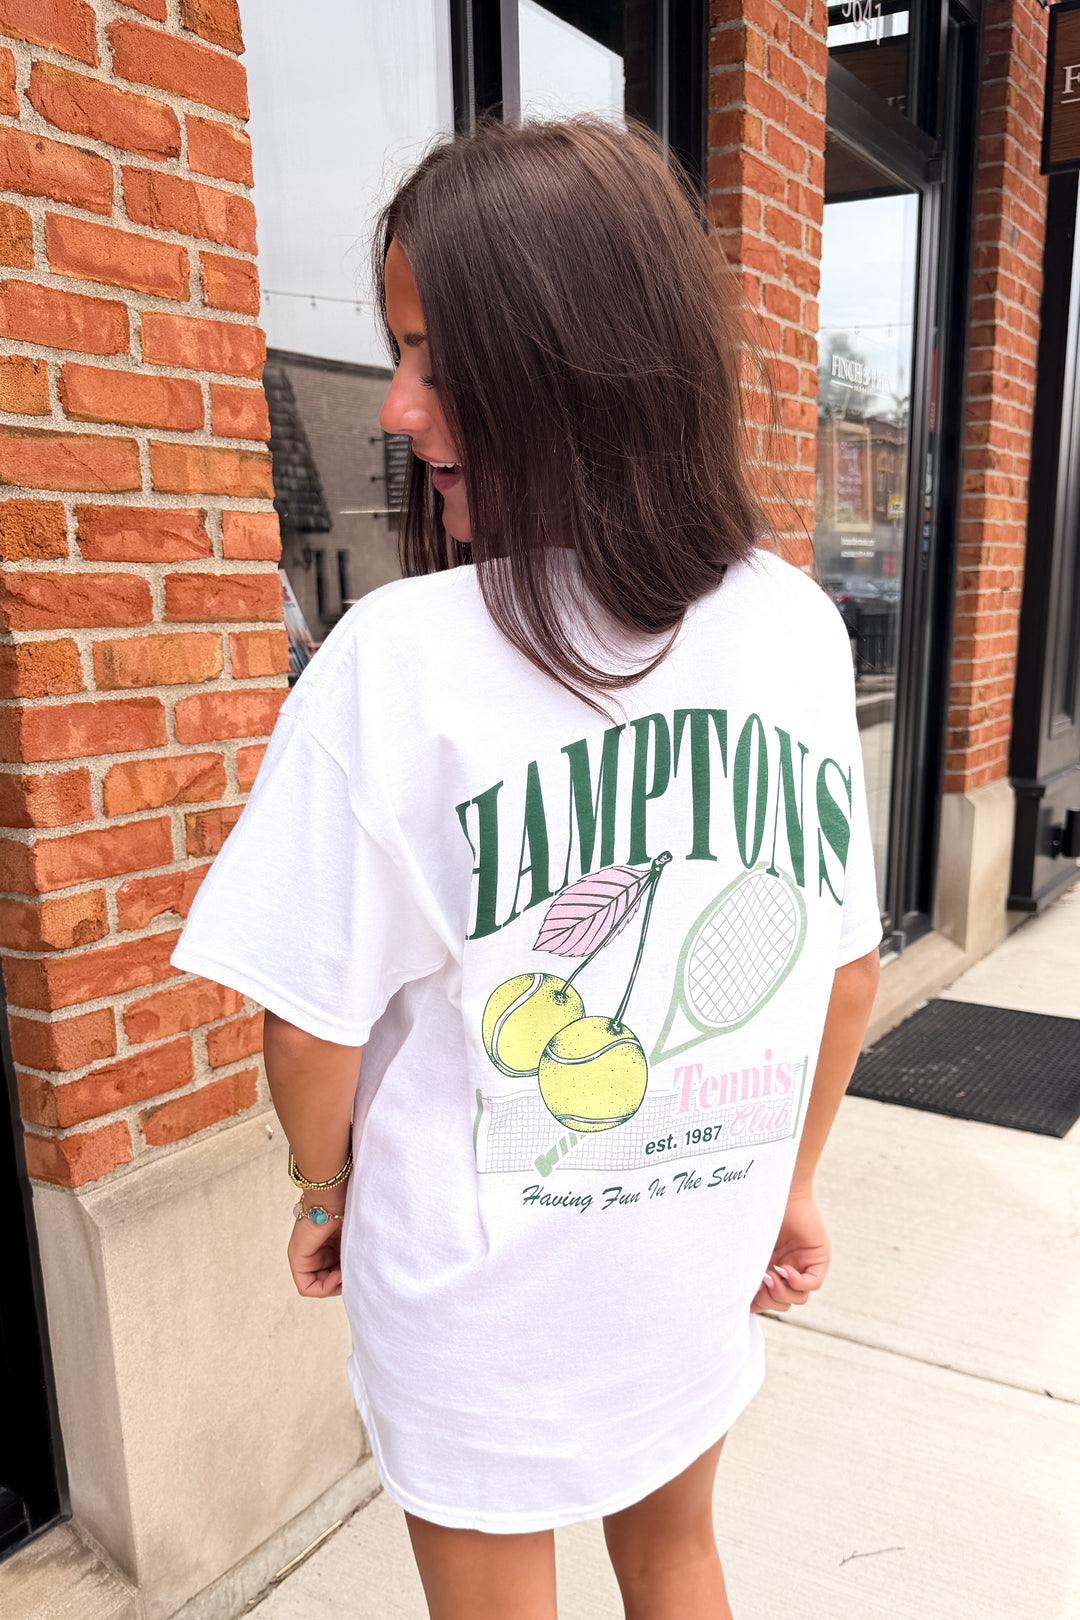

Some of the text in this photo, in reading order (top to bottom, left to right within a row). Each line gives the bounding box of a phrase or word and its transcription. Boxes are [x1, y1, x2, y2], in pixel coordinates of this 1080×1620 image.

[831, 355, 863, 384] FINCH
[456, 708, 853, 941] HAMPTONS
[672, 1048, 792, 1115] Tennis
[645, 1125, 722, 1155] est. 1987
[729, 1101, 789, 1137] Club
[522, 1159, 754, 1213] Having Fun In The Sun!
